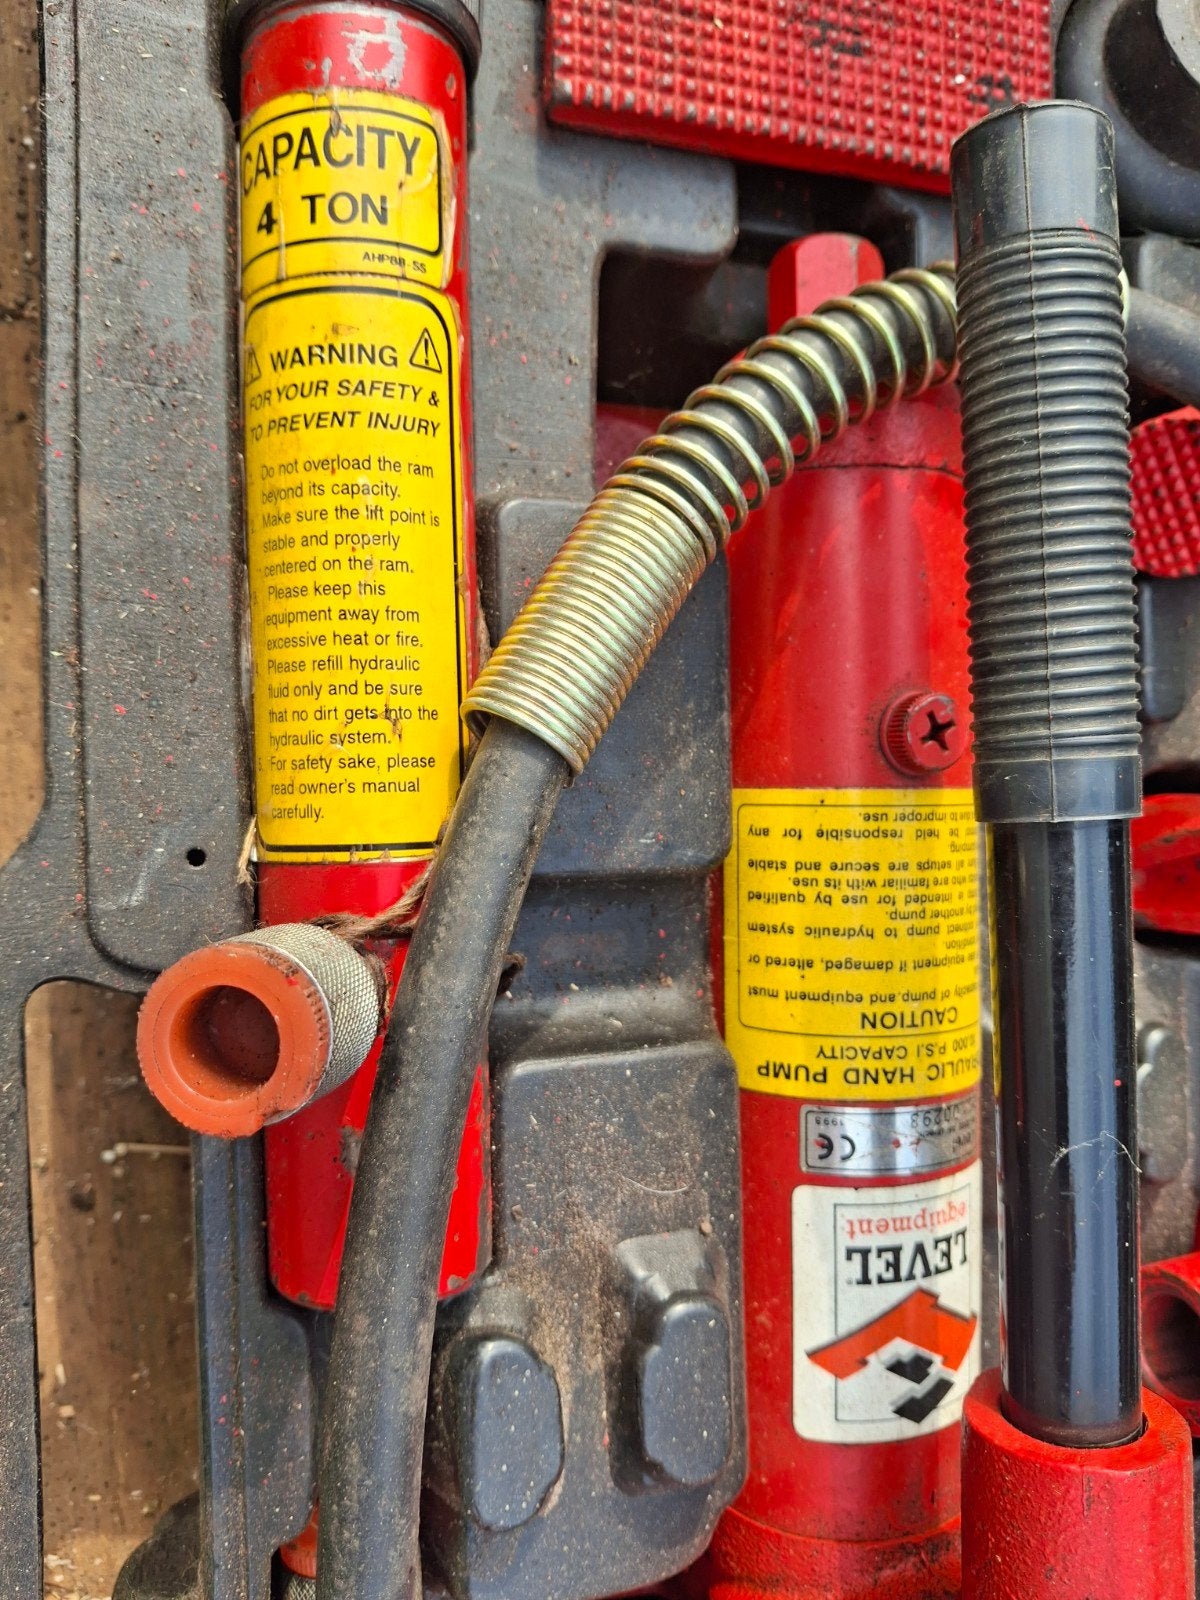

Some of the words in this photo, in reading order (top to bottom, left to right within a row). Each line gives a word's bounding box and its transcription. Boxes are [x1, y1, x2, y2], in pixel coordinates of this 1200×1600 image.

[244, 124, 421, 195] CAPACITY
[257, 202, 276, 235] 4
[302, 192, 388, 225] TON
[271, 343, 398, 371] WARNING
[276, 380, 328, 401] YOUR
[337, 380, 423, 401] SAFETY
[429, 391, 439, 407] &
[268, 411, 361, 438] PREVENT
[367, 412, 440, 437] INJURY
[261, 464, 274, 479] Do
[279, 461, 298, 476] not
[304, 455, 371, 472] overload
[378, 457, 401, 472] the
[408, 463, 433, 478] ram
[262, 481, 303, 505] beyond
[309, 482, 325, 496] its
[332, 483, 401, 501] capacity.
[262, 512, 291, 528] Make
[296, 508, 328, 523] sure
[335, 505, 359, 519] the
[366, 505, 384, 521] lift
[390, 510, 426, 525] point
[430, 513, 439, 527] is
[263, 535, 295, 553] stable
[301, 530, 328, 546] and
[335, 531, 400, 549] properly
[264, 556, 316, 577] centered
[322, 559, 341, 571] on
[348, 555, 373, 571] the
[380, 559, 414, 573] ram.
[268, 584, 308, 601] Please
[314, 581, 352, 598] keep
[358, 581, 386, 596] this
[266, 608, 332, 628] equipment
[338, 609, 379, 625] away
[385, 606, 420, 622] from
[267, 632, 327, 650] excessive
[333, 629, 368, 647] heat
[375, 632, 390, 646] or
[396, 631, 423, 648] fire.
[268, 658, 306, 674] Please
[312, 655, 343, 671] refill
[350, 656, 420, 674] hydraulic
[268, 682, 289, 700] fluid
[294, 683, 322, 700] only
[329, 680, 358, 695] and
[365, 680, 384, 695] be
[390, 683, 423, 695] sure
[269, 708, 287, 723] that
[292, 709, 308, 721] no
[314, 706, 338, 721] dirt
[344, 707, 378, 724] gets
[418, 705, 439, 720] the
[269, 731, 324, 751] hydraulic
[329, 731, 392, 748] system.
[270, 755, 287, 770] For
[291, 755, 332, 773] safety
[387, 754, 436, 772] please
[271, 779, 294, 796] read
[299, 779, 356, 794] owner's
[363, 778, 420, 793] manual
[272, 803, 324, 823] carefully.
[859, 811, 888, 822] use.
[894, 809, 946, 824] improper
[950, 811, 957, 822] to
[748, 824, 770, 838] any
[782, 828, 802, 839] for
[816, 826, 903, 840] responsible
[916, 828, 940, 840] held
[949, 828, 958, 838] be
[748, 859, 787, 871] stable
[794, 860, 822, 873] and
[830, 861, 880, 872] secure
[888, 861, 909, 872] are
[916, 858, 952, 872] setups
[788, 877, 818, 888] use.
[824, 878, 841, 890] its
[846, 878, 876, 890] with
[882, 877, 930, 890] familiar
[933, 877, 949, 887] are
[748, 890, 805, 904] qualified
[814, 892, 832, 906] by
[841, 894, 868, 904] use
[877, 894, 896, 906] for
[904, 892, 952, 906] intended
[885, 907, 926, 921] pump.
[930, 907, 964, 920] another
[747, 921, 794, 935] system
[804, 925, 874, 940] hydraulic
[884, 927, 897, 939] to
[906, 923, 940, 937] pump
[748, 954, 760, 964] or
[765, 955, 814, 969] altered
[899, 960, 907, 972] if
[913, 954, 965, 970] equipment
[748, 985, 778, 999] must
[783, 987, 863, 1005] equipment
[870, 992, 896, 1005] and
[941, 989, 950, 1001] of
[860, 1006, 958, 1029] CAUTION
[815, 1044, 908, 1060] CAPACITY
[757, 1060, 828, 1083] PUMP
[843, 1065, 914, 1084] HAND
[845, 1201, 966, 1240] equipment
[846, 1227, 967, 1286] LEVEL
